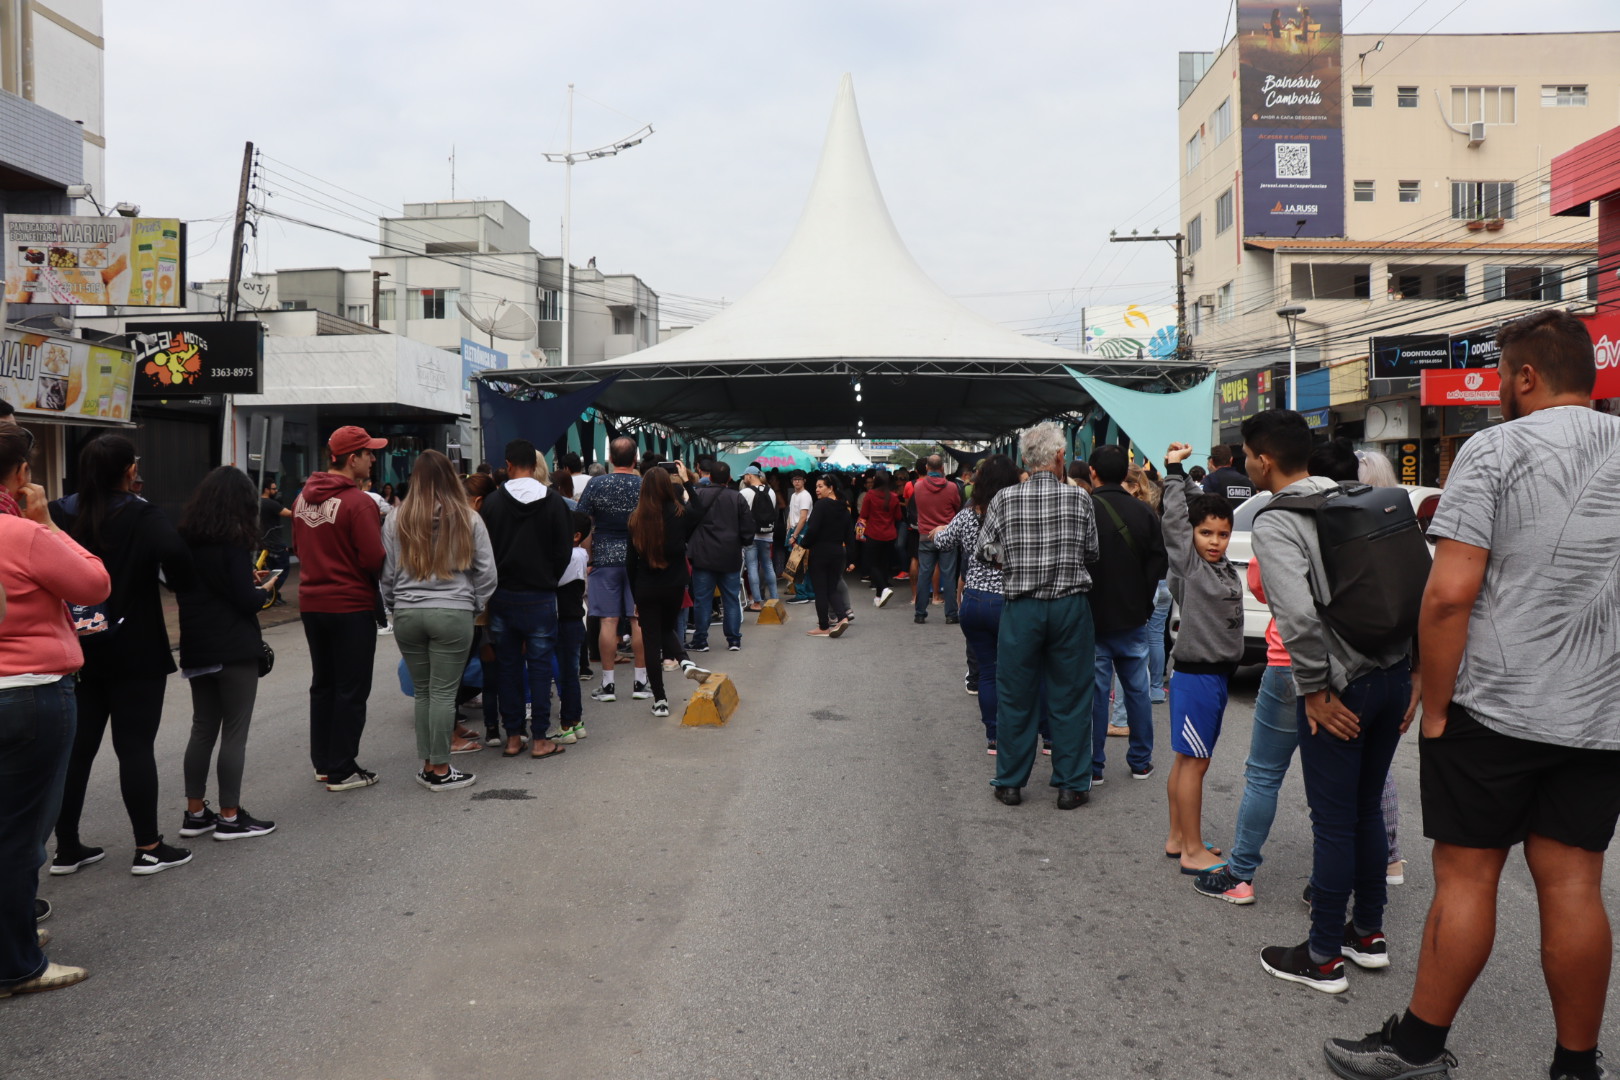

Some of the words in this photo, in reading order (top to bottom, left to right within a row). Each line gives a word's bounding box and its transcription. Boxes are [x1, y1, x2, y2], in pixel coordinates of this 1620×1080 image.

[1262, 75, 1321, 94] Balneário
[1265, 91, 1321, 107] Camboriú
[61, 224, 117, 243] MARIAH
[183, 331, 208, 351] MOTOS
[1401, 350, 1447, 358] ODONTOLOGIA
[211, 367, 254, 377] 3363-8975
[1447, 389, 1475, 399] MÓVEIS
[1229, 488, 1250, 497] GMBC
